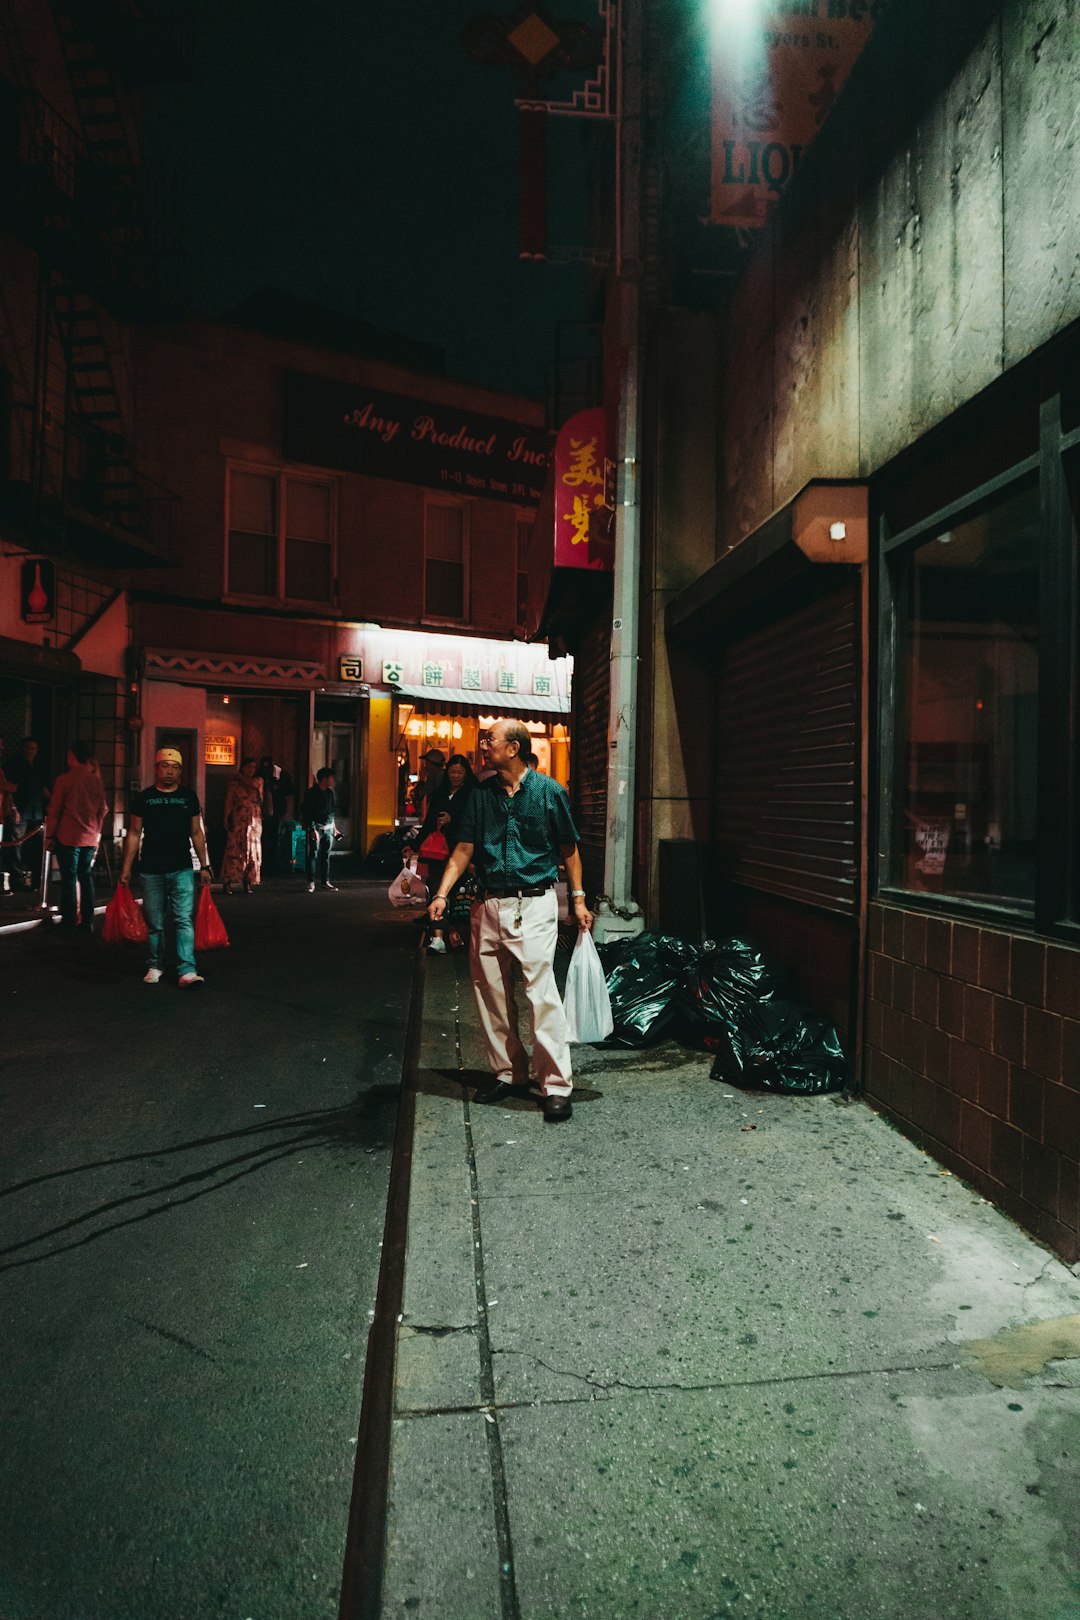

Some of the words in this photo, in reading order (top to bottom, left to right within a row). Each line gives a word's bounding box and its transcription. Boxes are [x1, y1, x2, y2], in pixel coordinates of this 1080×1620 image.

[343, 402, 400, 442] Any
[411, 415, 496, 455] Product
[507, 436, 550, 467] Inc.
